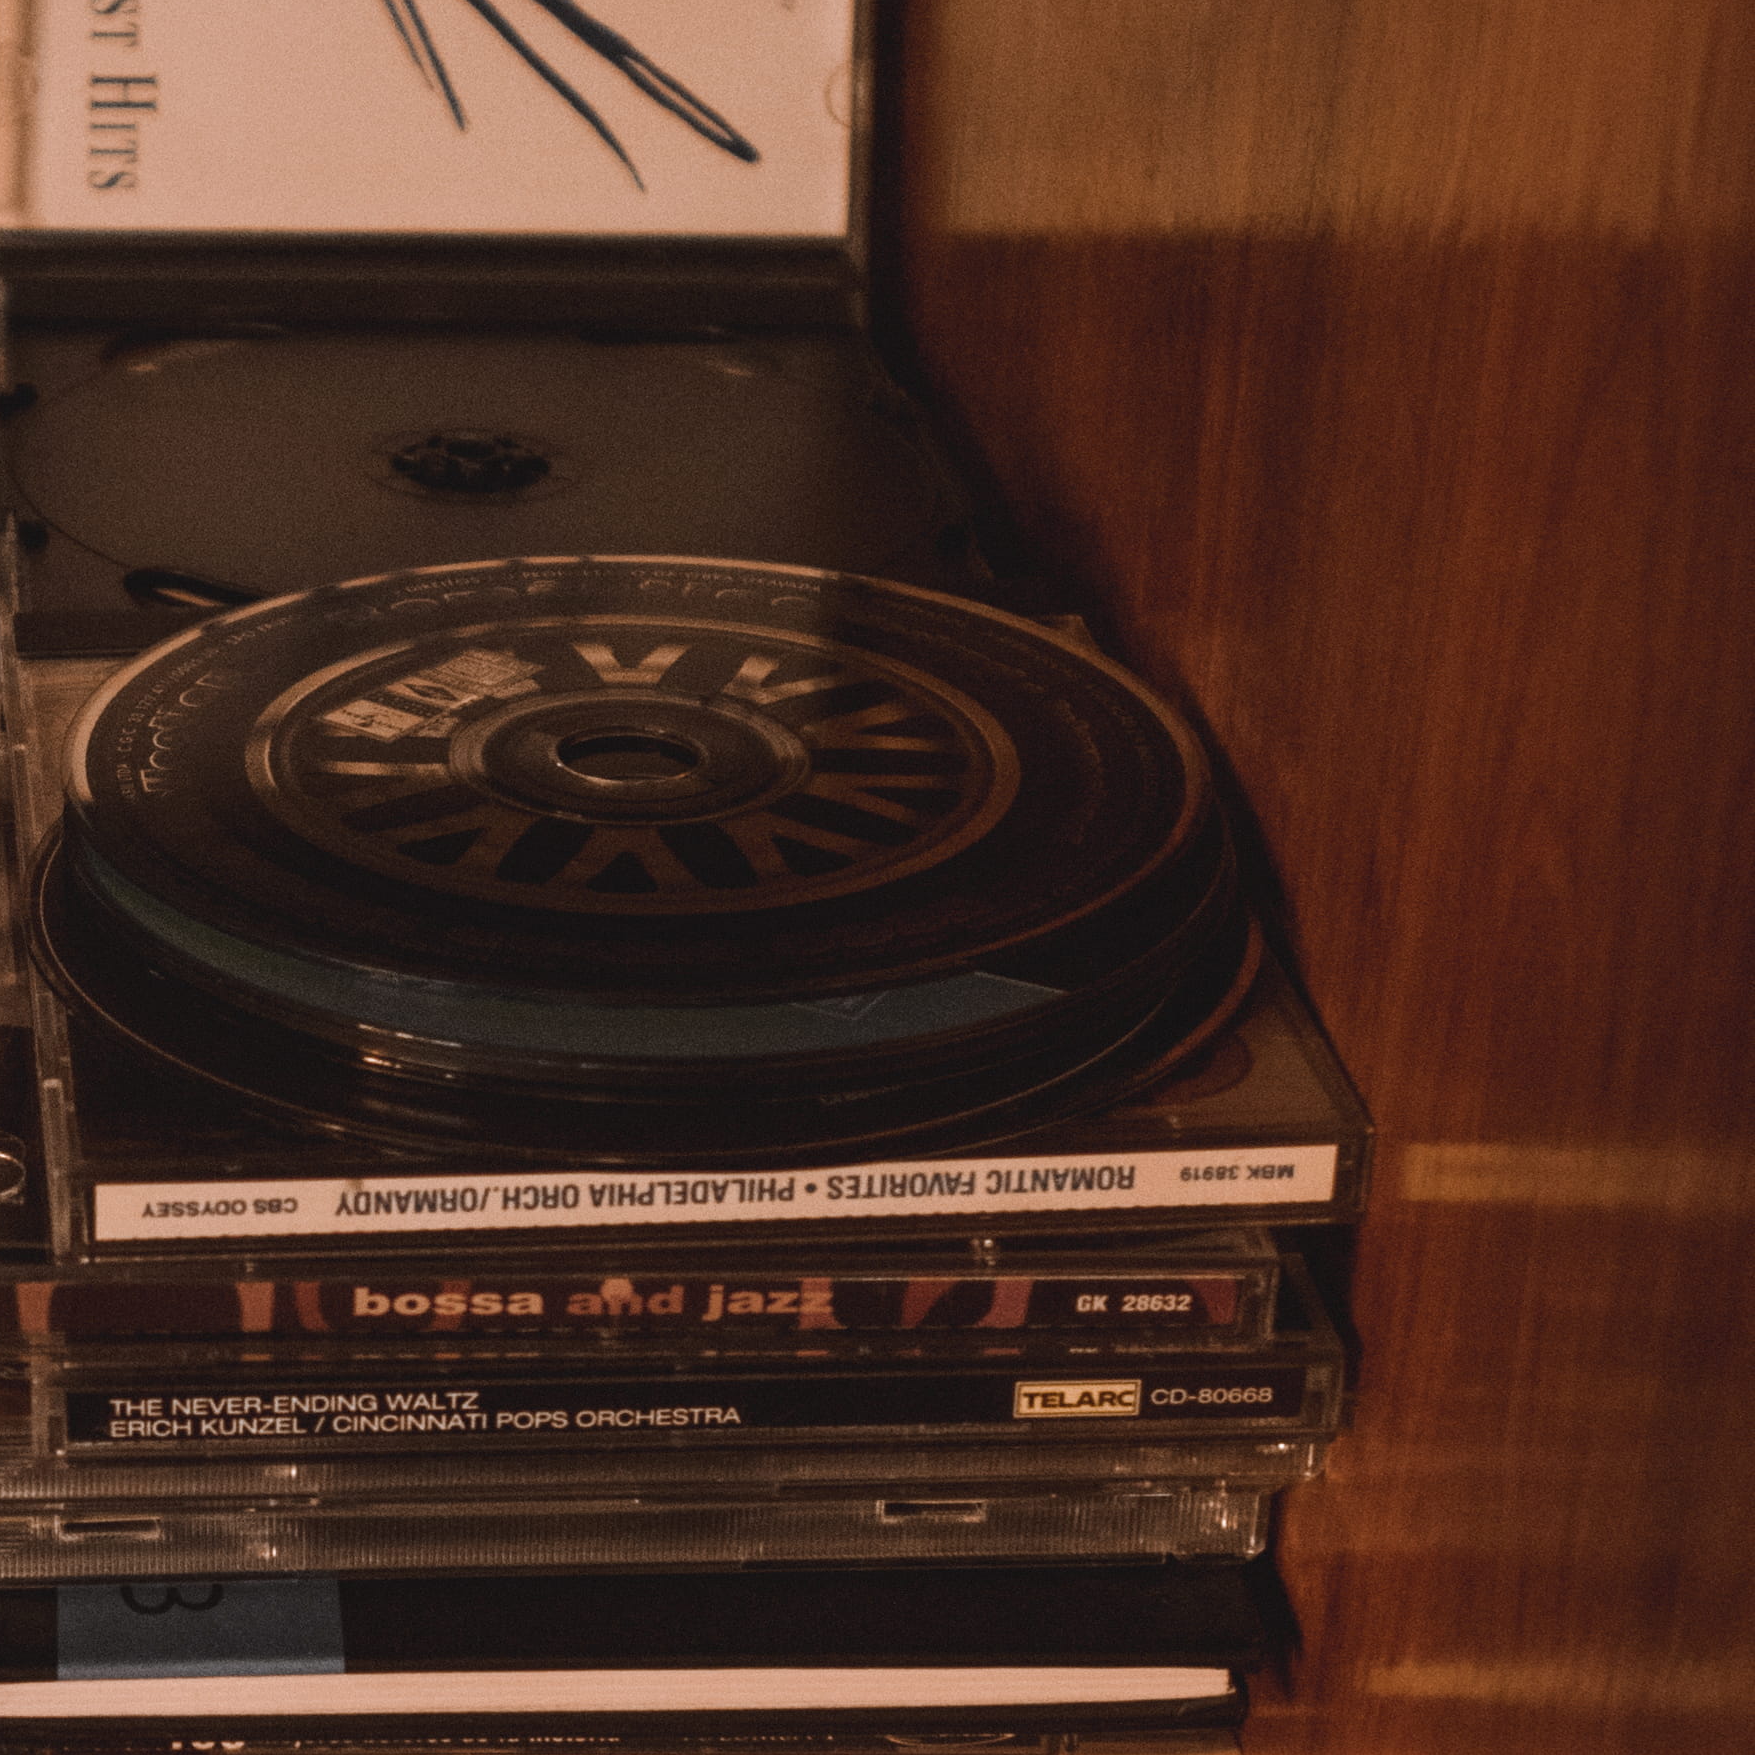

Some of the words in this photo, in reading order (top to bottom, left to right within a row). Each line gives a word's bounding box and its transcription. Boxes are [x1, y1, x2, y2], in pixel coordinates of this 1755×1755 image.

[87, 73, 159, 192] HITS
[826, 1172, 979, 1200] FAVORITES
[983, 1165, 1136, 1195] ROMANTIC
[1179, 1166, 1241, 1184] 38919
[334, 1184, 582, 1215] ORCH./ORMANDY
[587, 1174, 796, 1205] PHILADELPHIA
[141, 1200, 248, 1220] ODYSSEY
[252, 1199, 299, 1217] CBS
[352, 1282, 544, 1317] bossa
[567, 1278, 685, 1317] and
[700, 1280, 835, 1320] jazz
[1121, 1290, 1193, 1309] 28632
[110, 1394, 165, 1414] THE
[171, 1391, 380, 1412] NEVER-ENDING
[385, 1388, 481, 1408] WALTZ
[1023, 1389, 1135, 1407] TELARC
[1149, 1384, 1275, 1404] CD-80668
[110, 1416, 193, 1436] ERICH
[200, 1414, 308, 1434] KUNZEL
[331, 1409, 489, 1432] CINCINNATI
[496, 1407, 570, 1427] POPS
[575, 1403, 743, 1424] ORCHESTRA
